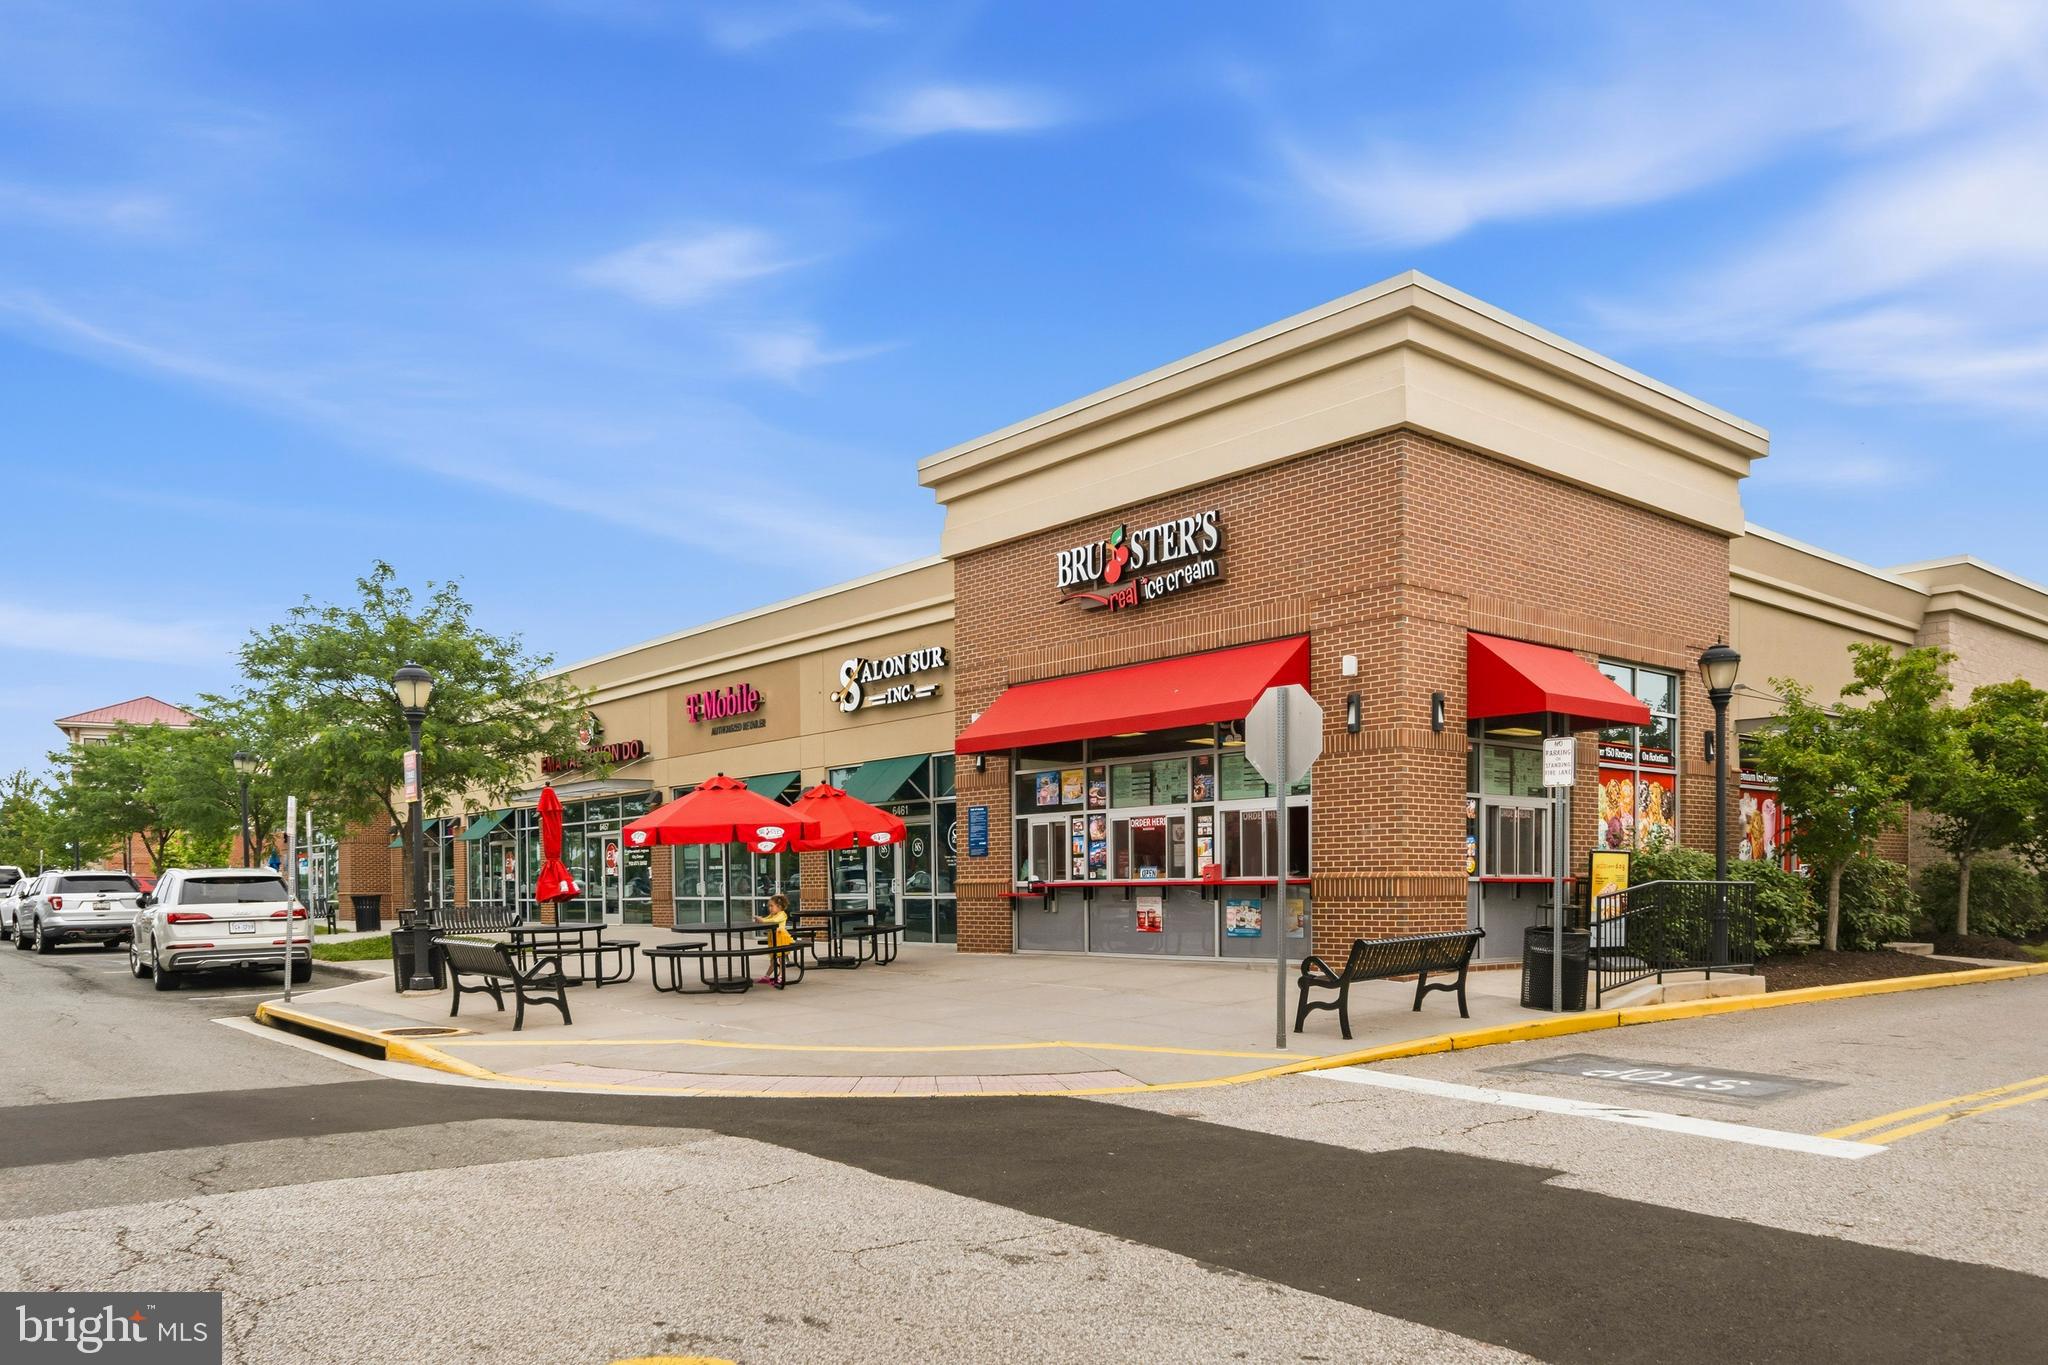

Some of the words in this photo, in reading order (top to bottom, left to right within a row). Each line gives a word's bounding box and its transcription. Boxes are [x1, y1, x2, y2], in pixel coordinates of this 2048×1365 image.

[1109, 577, 1139, 612] real
[1143, 577, 1164, 600] ice
[1166, 559, 1216, 592] cream
[840, 657, 907, 712] SALON
[909, 646, 945, 674] SUR
[886, 684, 914, 704] INC.
[622, 740, 639, 760] DO
[892, 805, 909, 816] 6461
[1243, 811, 1262, 821] ORDE
[1130, 818, 1151, 828] ORDER
[1141, 869, 1156, 878] OPEN
[1582, 1068, 1751, 1091] STOP
